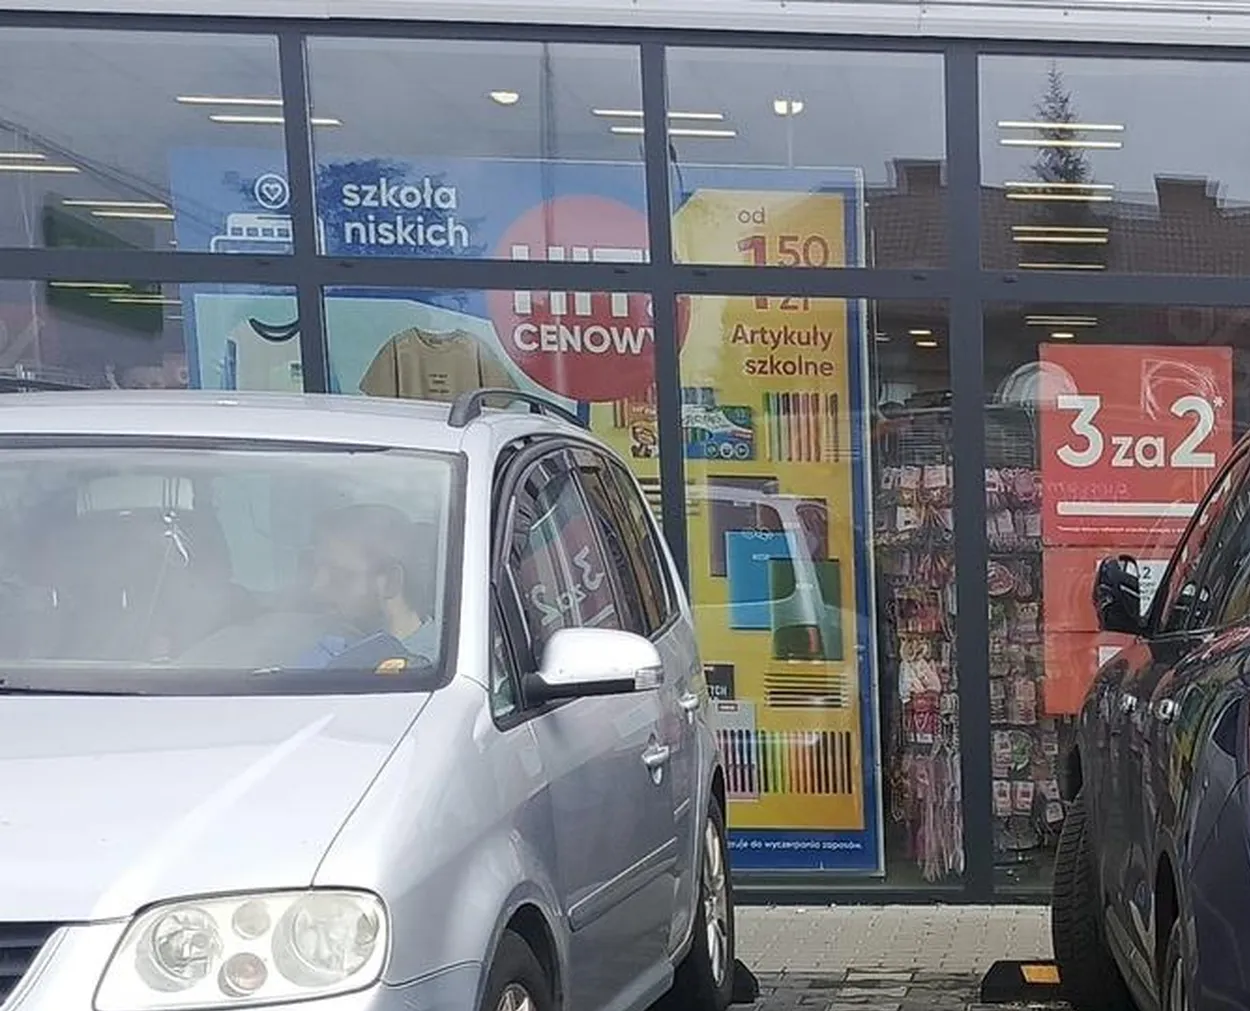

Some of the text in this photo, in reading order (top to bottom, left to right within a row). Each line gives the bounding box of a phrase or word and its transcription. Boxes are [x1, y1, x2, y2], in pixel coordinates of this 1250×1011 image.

[342, 177, 457, 209] szkoła
[344, 215, 469, 248] niskich
[738, 208, 766, 225] od
[513, 324, 655, 354] CENOW
[731, 323, 833, 351] Artykuły
[744, 355, 834, 377] szkolne
[1056, 395, 1104, 468] 3
[1111, 436, 1166, 468] za
